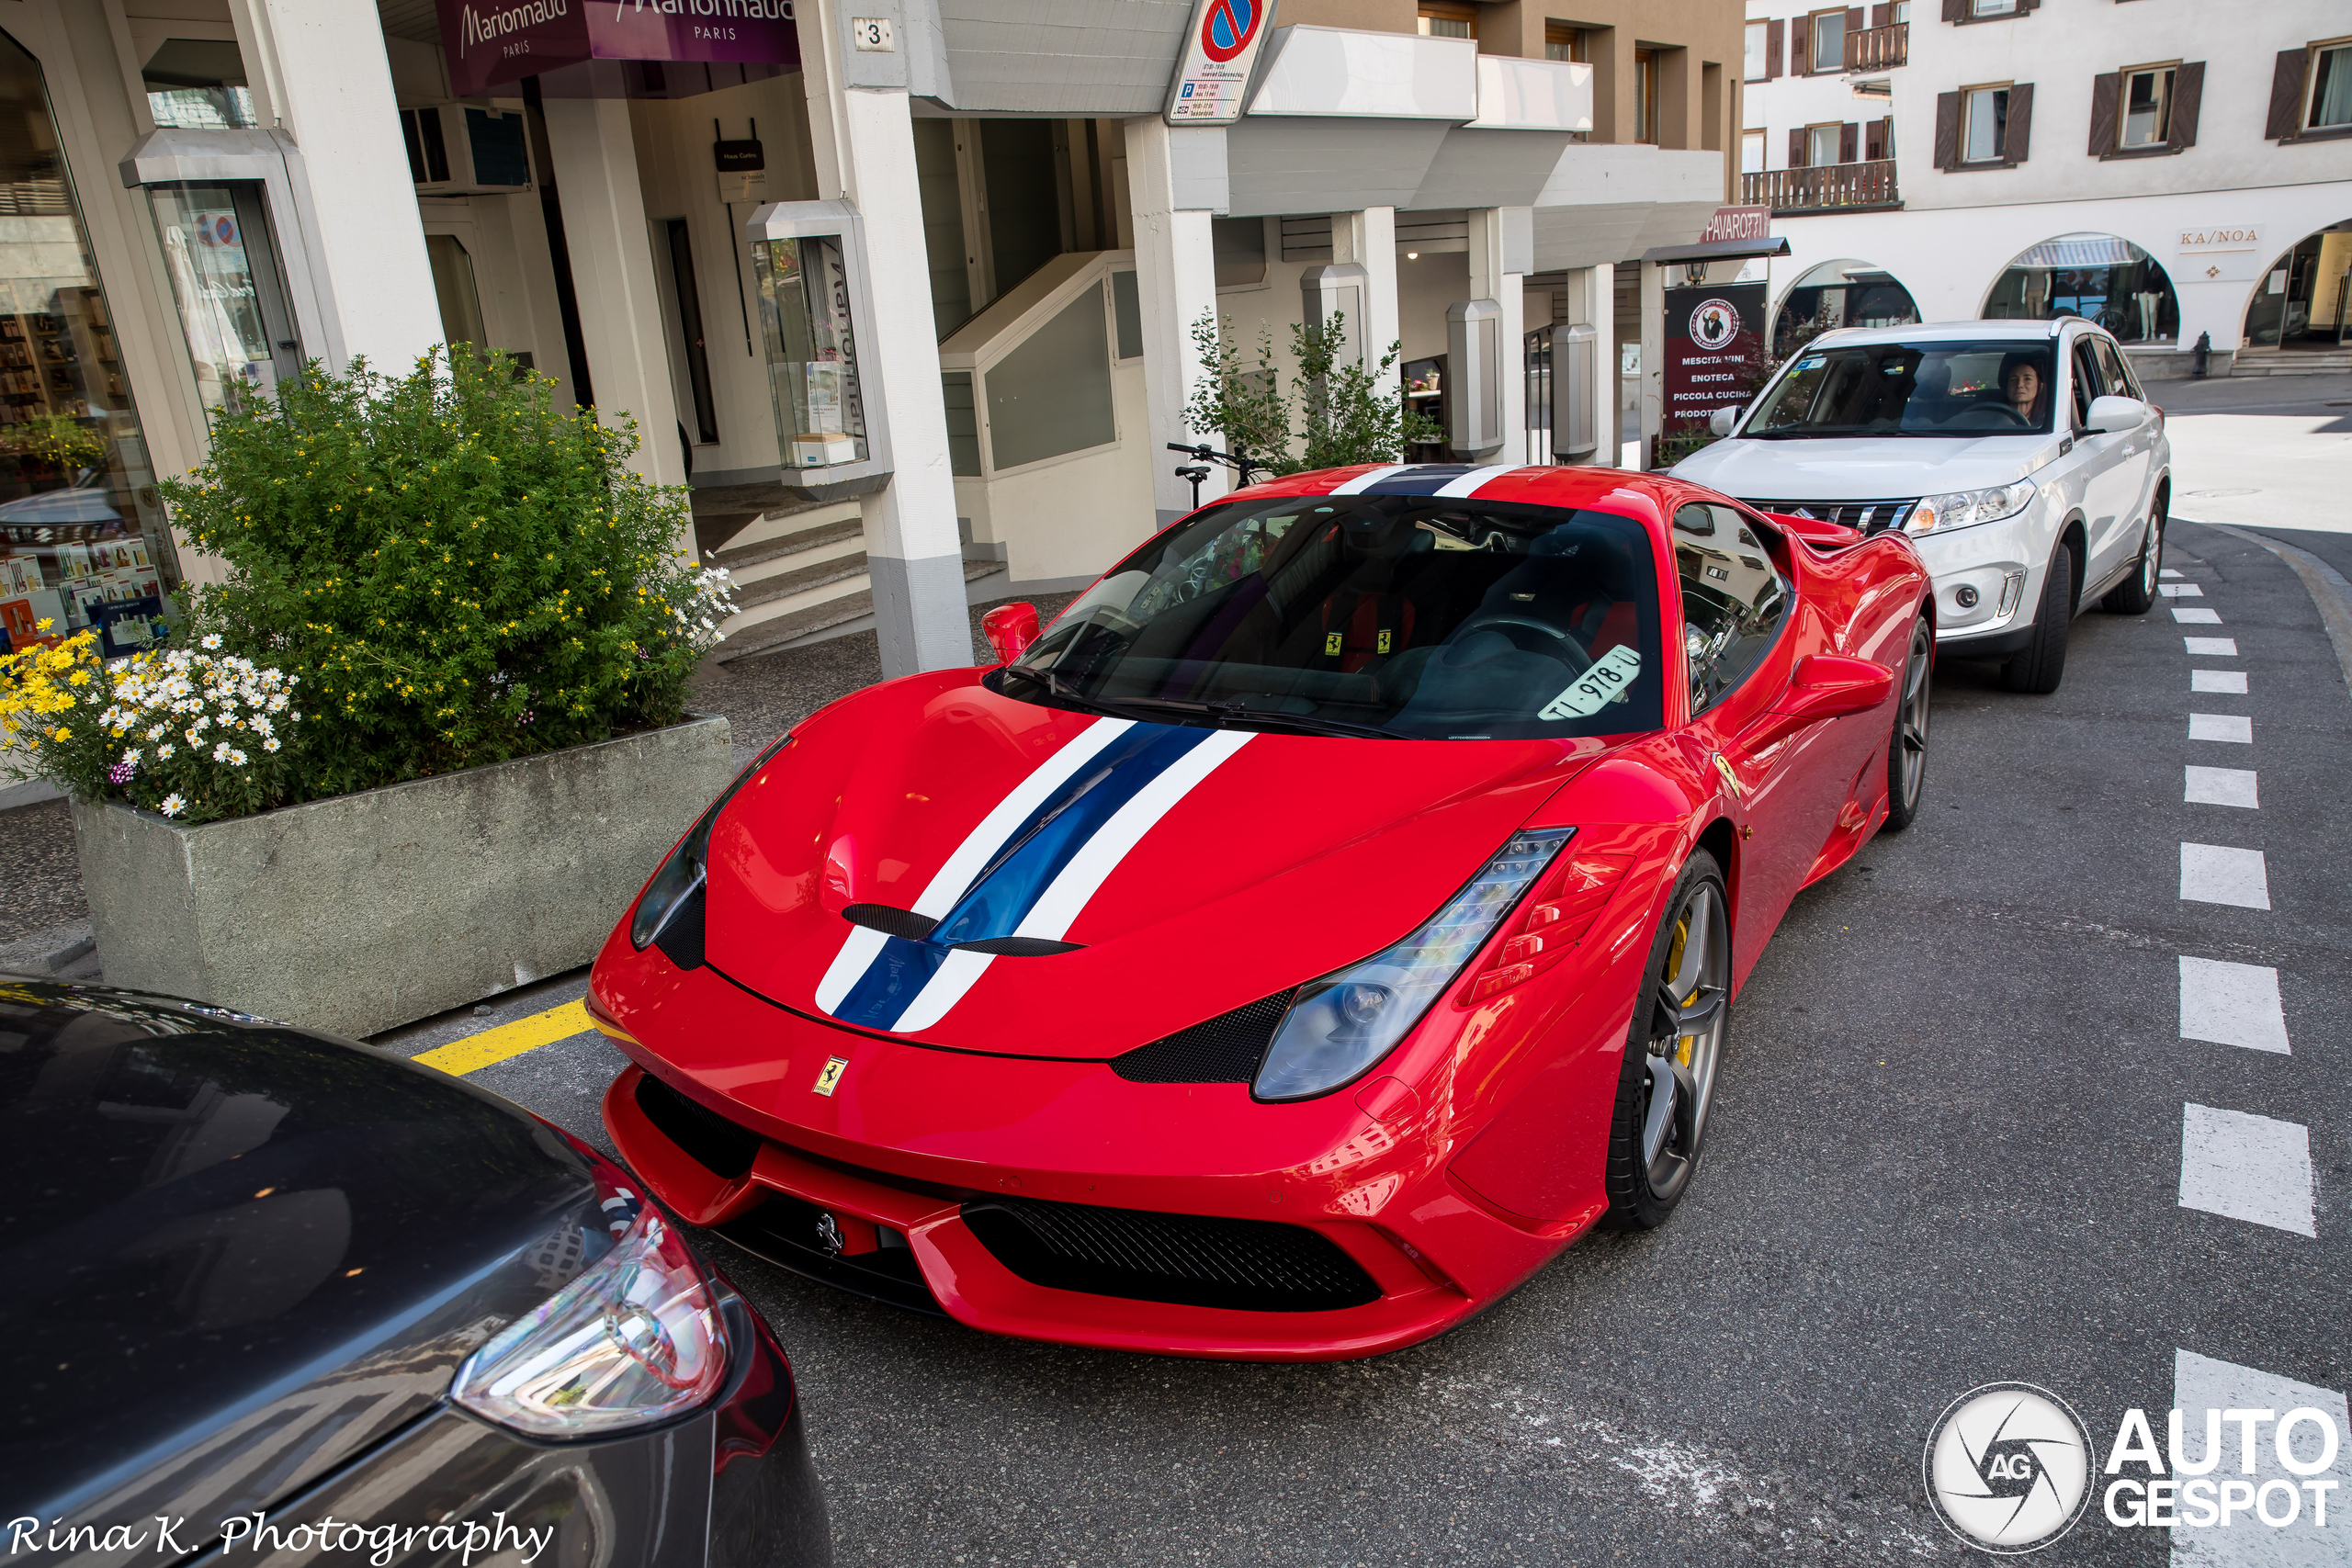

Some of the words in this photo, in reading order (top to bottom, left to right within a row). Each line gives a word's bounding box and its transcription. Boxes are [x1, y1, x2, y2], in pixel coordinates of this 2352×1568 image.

[694, 26, 737, 40] PARIS
[868, 23, 881, 45] 3
[503, 39, 530, 59] PARIS
[1706, 212, 1762, 242] PAVAROTTI
[2180, 230, 2257, 244] KA/NOA
[1682, 356, 1722, 366] MESCITA
[1724, 355, 1745, 364] VINI
[1691, 373, 1735, 383] ENOTECA
[1673, 392, 1713, 401] PICCOLA
